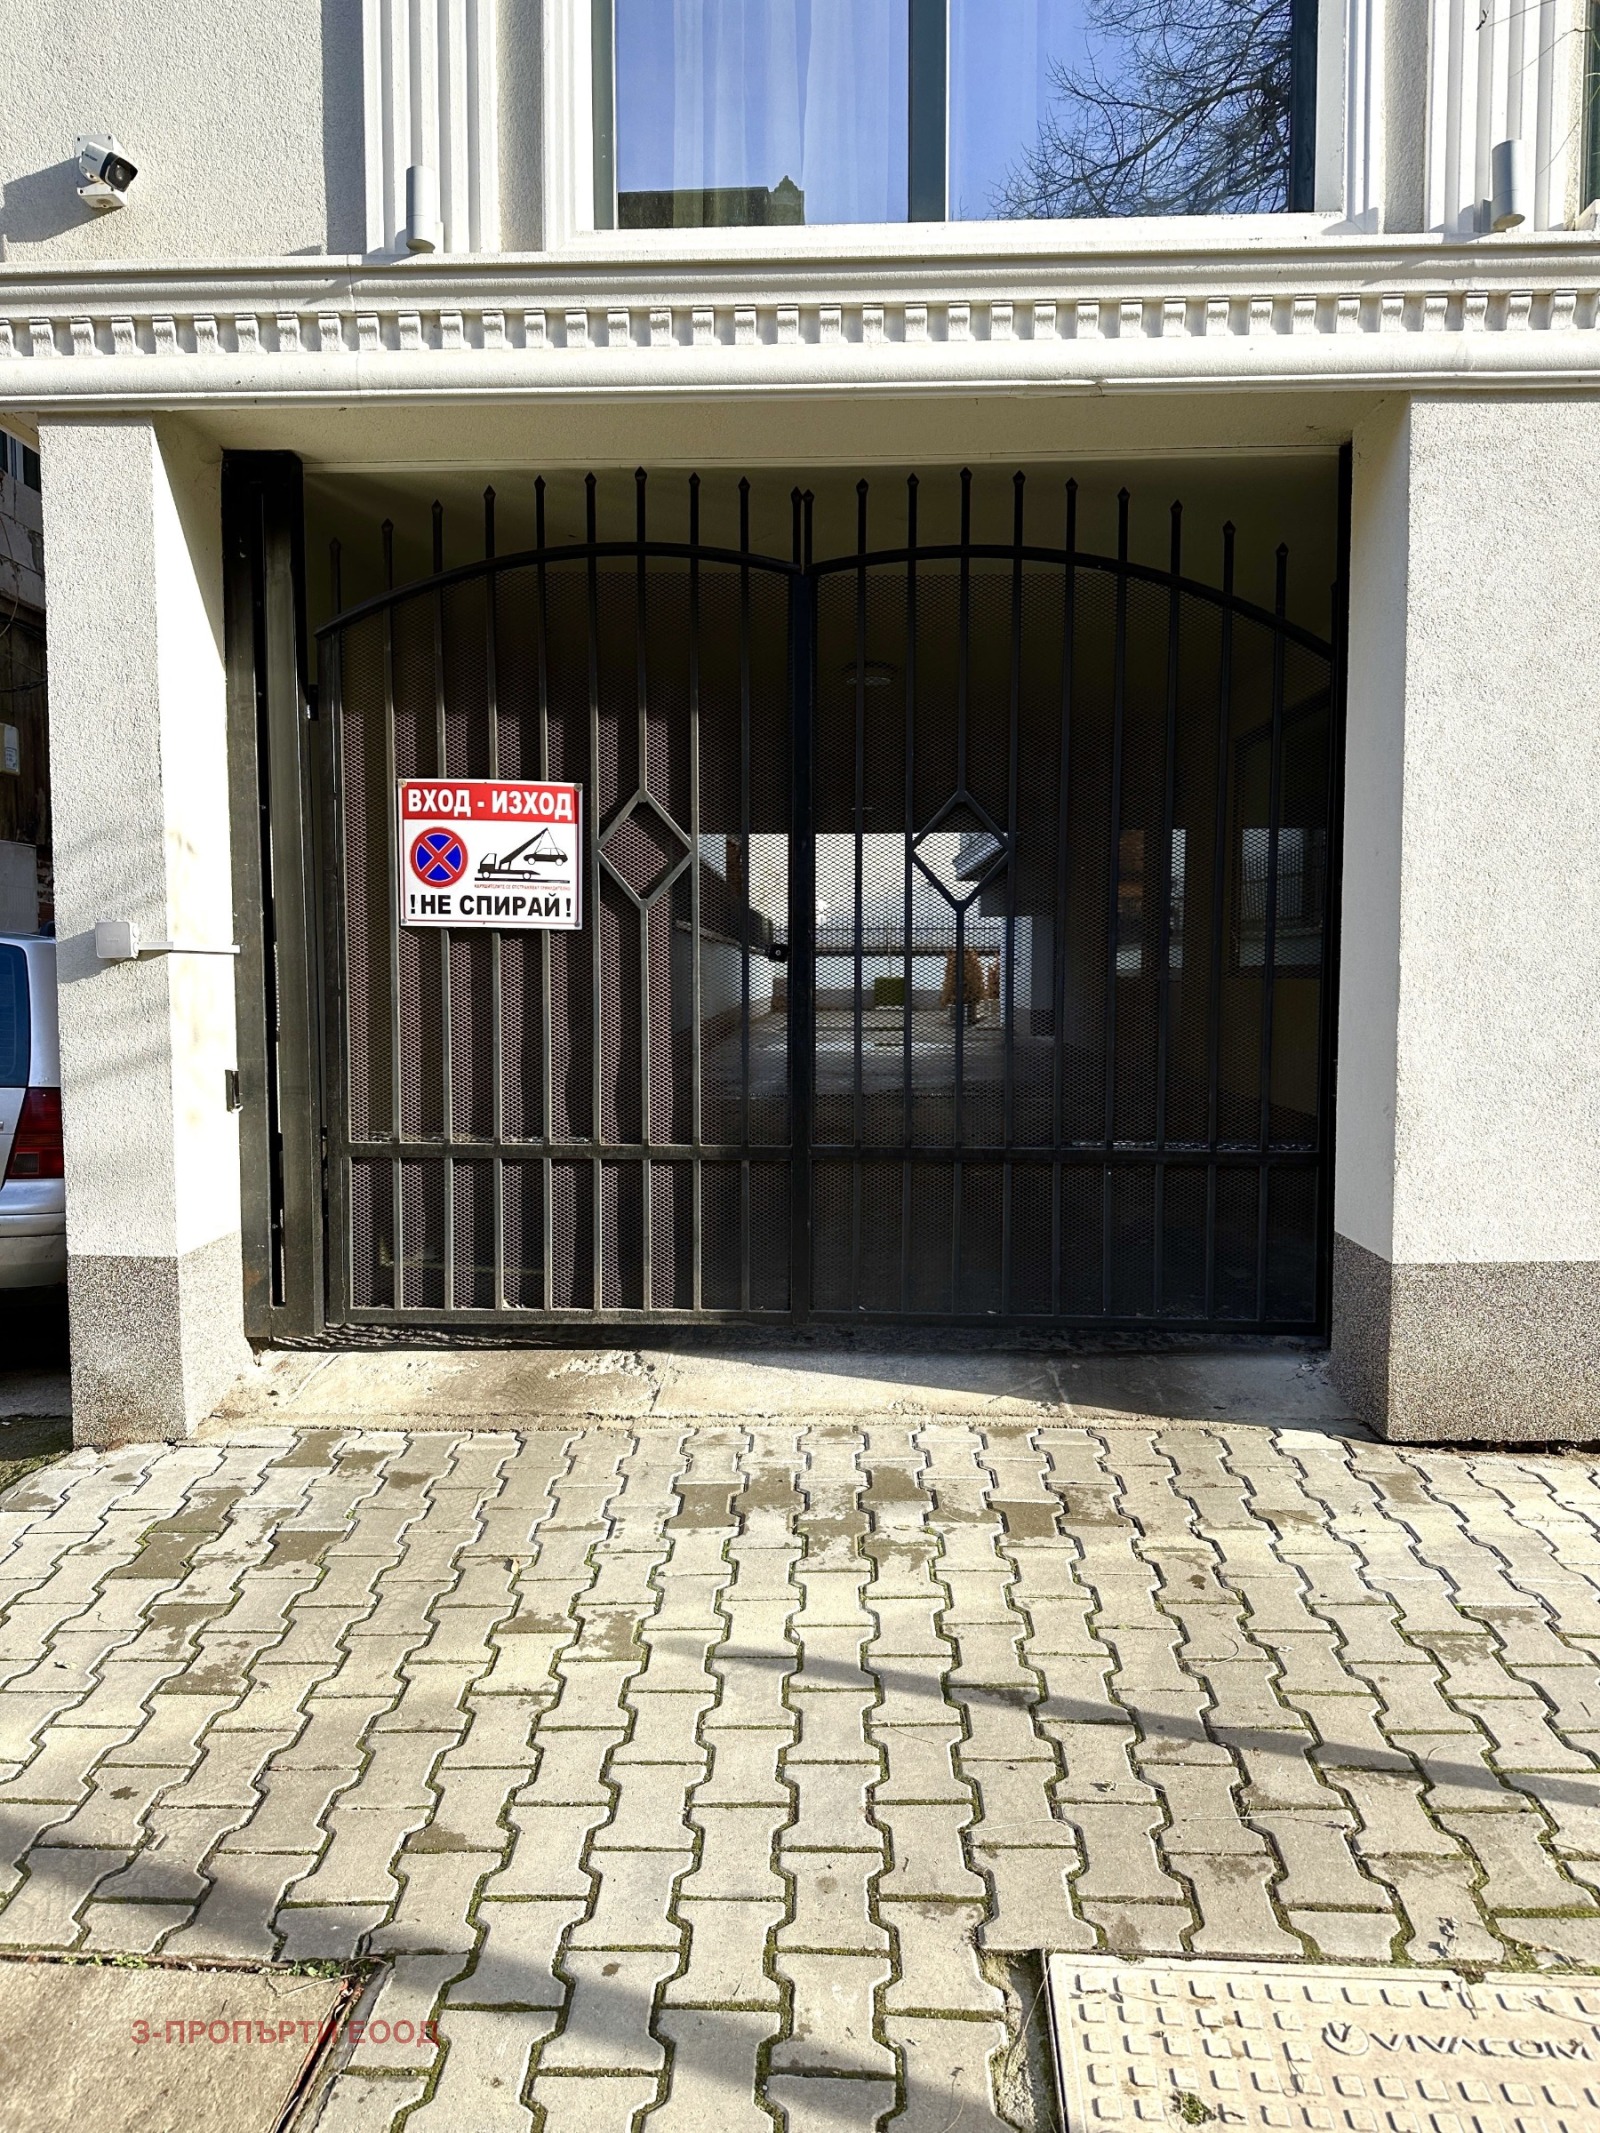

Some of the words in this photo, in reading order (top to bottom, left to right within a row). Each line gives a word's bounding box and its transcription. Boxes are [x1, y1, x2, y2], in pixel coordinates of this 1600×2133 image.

[408, 789, 471, 817] ВХОД
[491, 790, 573, 821] ИЗХОД
[1369, 2033, 1595, 2061] VIVACOM
